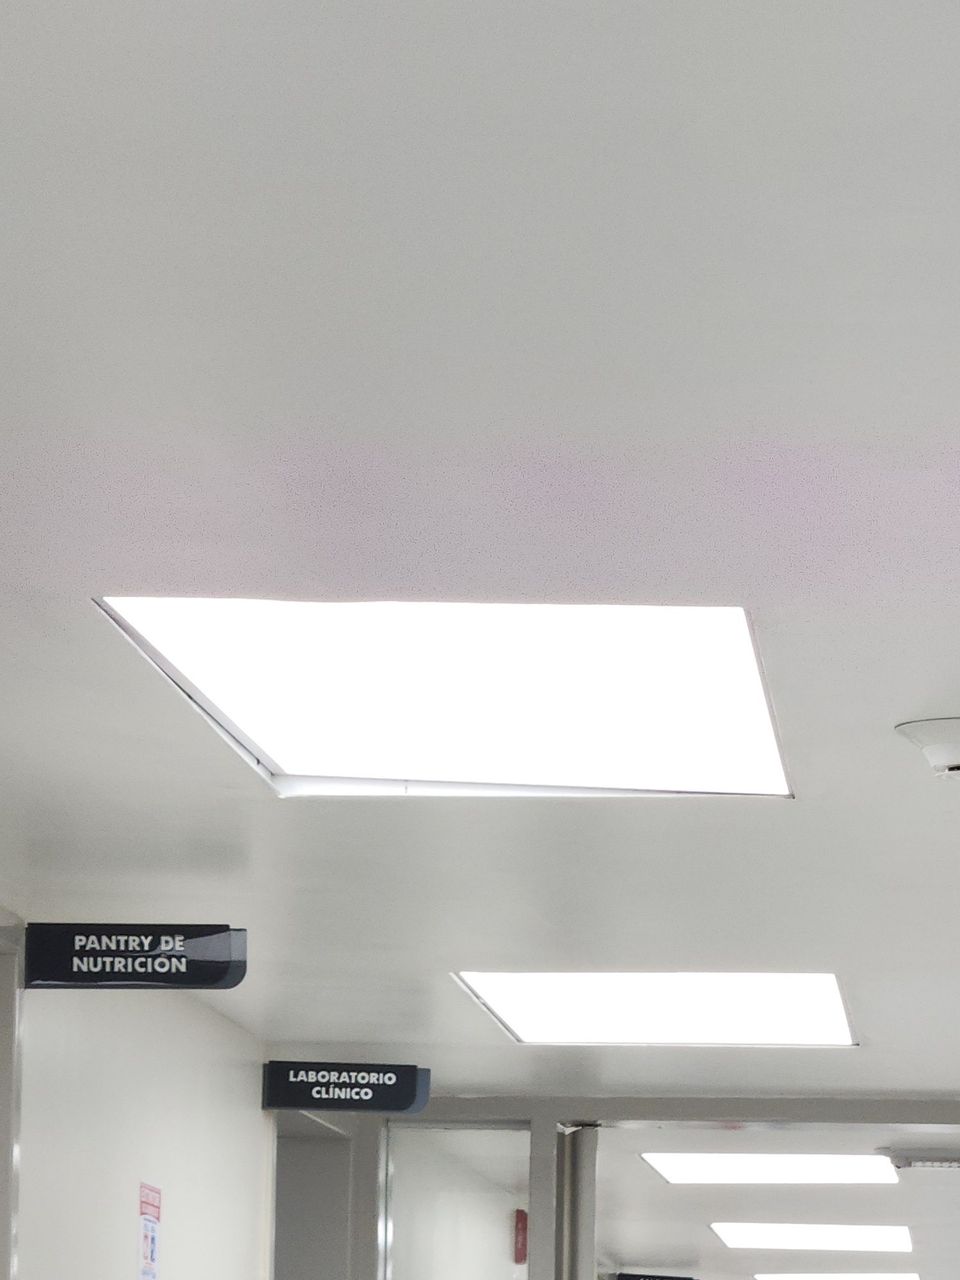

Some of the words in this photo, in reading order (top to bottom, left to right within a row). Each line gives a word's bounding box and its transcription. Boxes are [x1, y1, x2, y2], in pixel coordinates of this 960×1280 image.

[74, 935, 153, 951] PANTRY
[161, 935, 185, 951] DE
[72, 953, 187, 973] NUTRICIÓN
[288, 1070, 397, 1085] LABORATORIO
[311, 1085, 374, 1100] CLÍNICO
